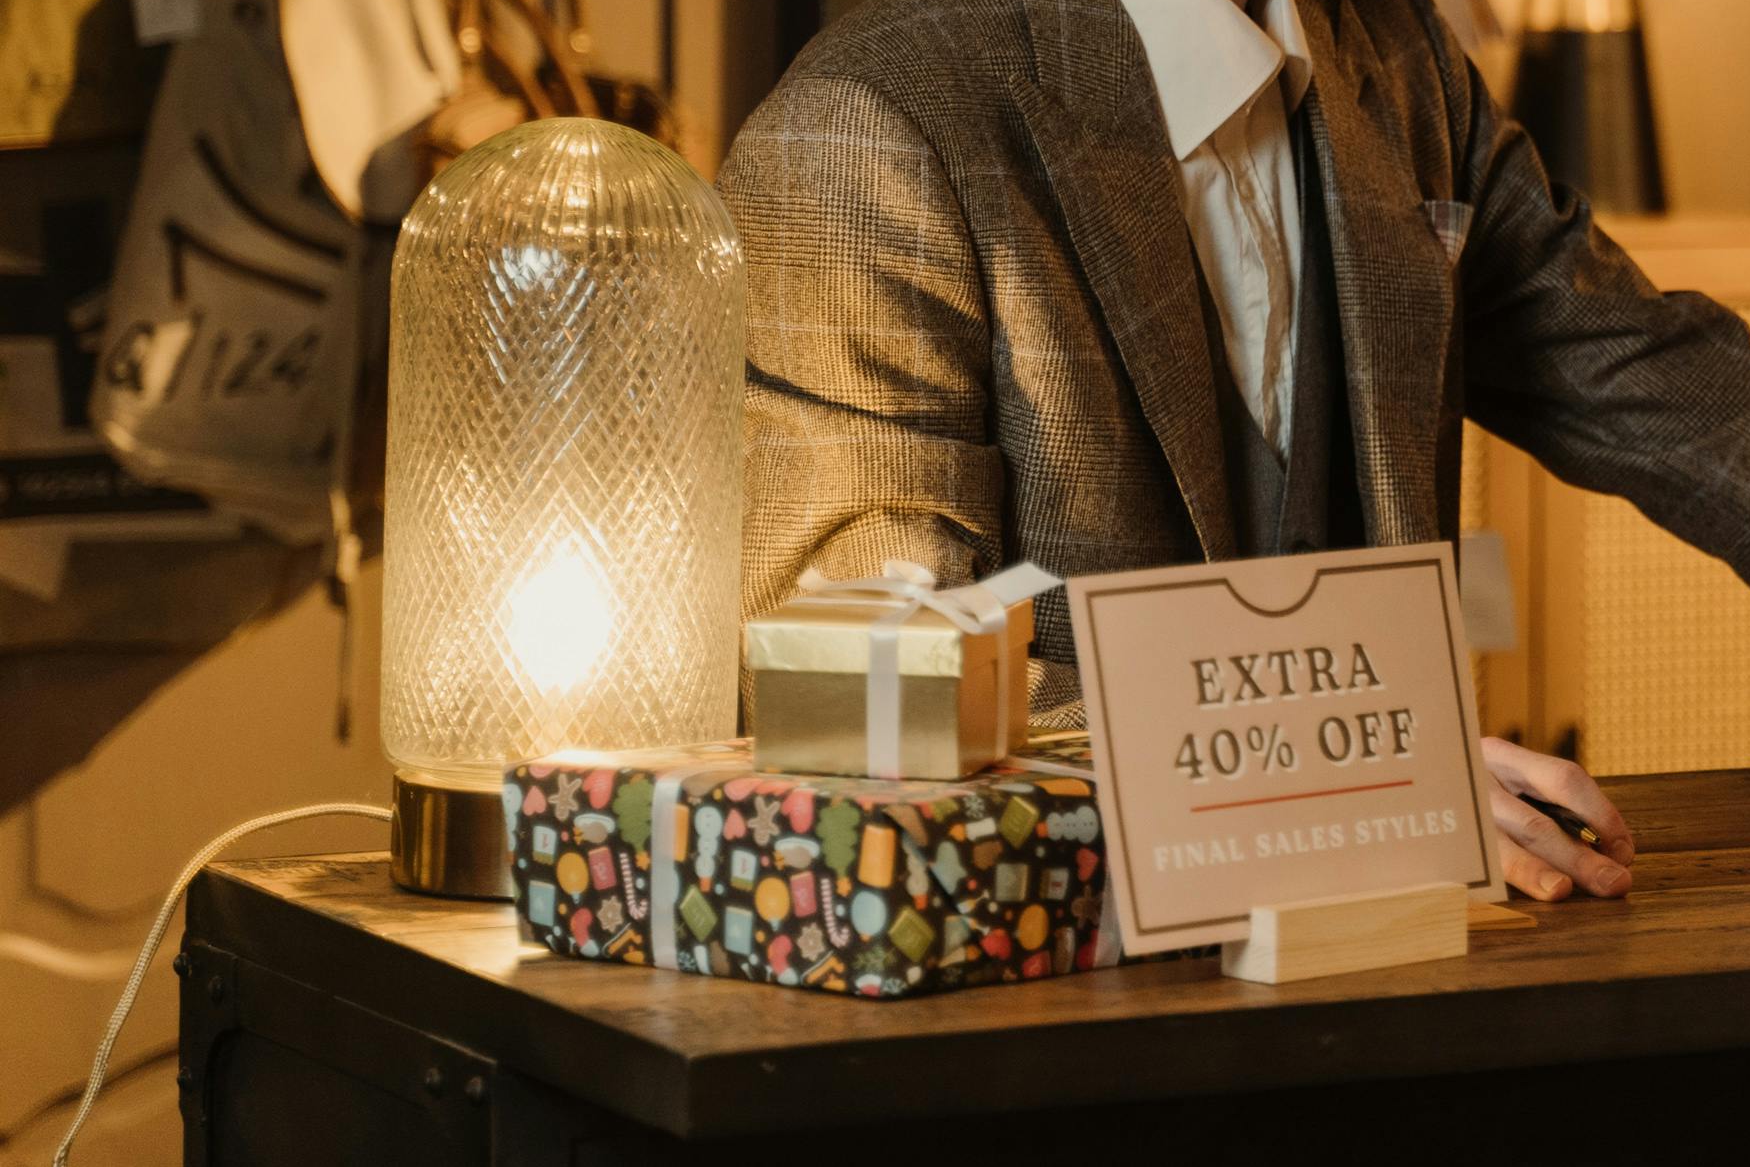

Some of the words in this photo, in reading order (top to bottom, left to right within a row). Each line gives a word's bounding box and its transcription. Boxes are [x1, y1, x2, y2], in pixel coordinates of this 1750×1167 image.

[1190, 642, 1383, 707] EXTRA
[1174, 723, 1296, 781] 40%
[1317, 707, 1414, 764] OFF
[1152, 837, 1246, 872] FINAL
[1255, 823, 1346, 859] SALES
[1353, 808, 1459, 845] STYLES
